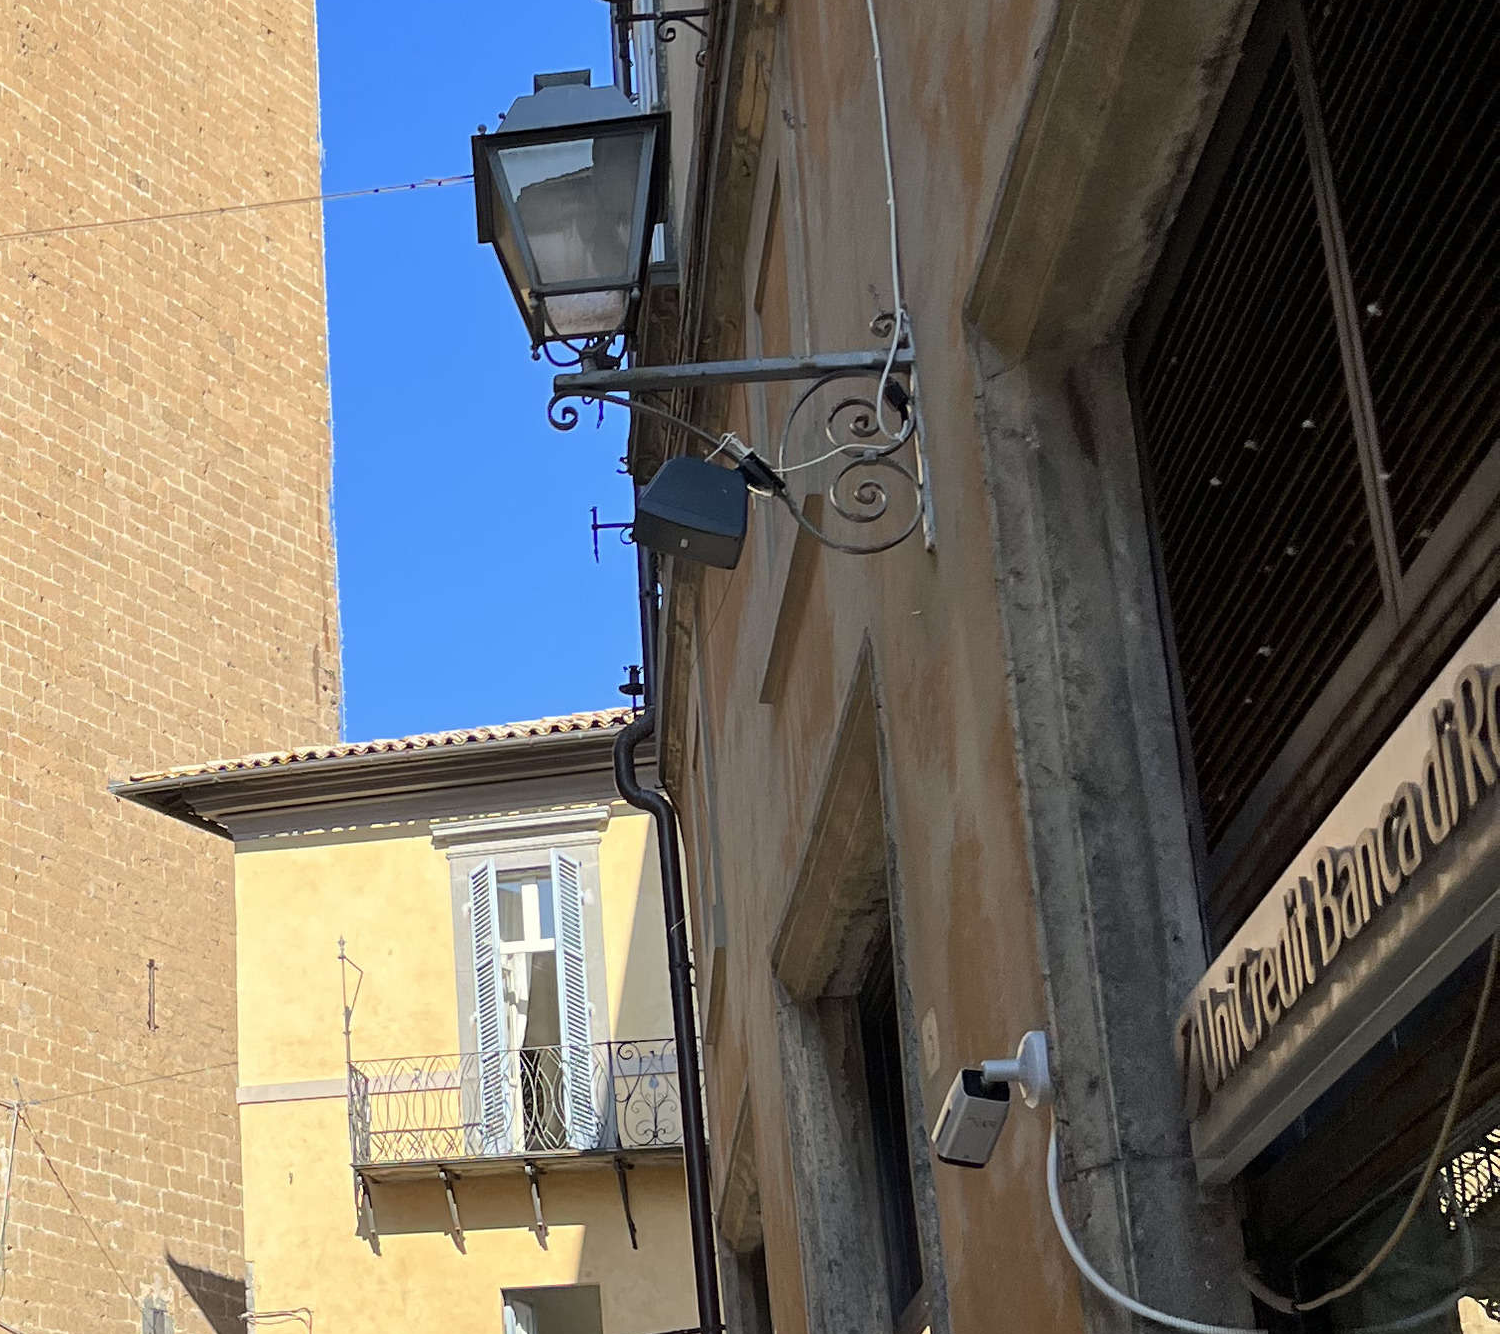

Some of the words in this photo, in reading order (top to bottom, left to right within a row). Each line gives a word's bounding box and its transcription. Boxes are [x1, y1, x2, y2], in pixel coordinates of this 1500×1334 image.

[1198, 876, 1315, 1092] UniCredit
[1311, 781, 1421, 965] Banca
[1422, 699, 1458, 845] di
